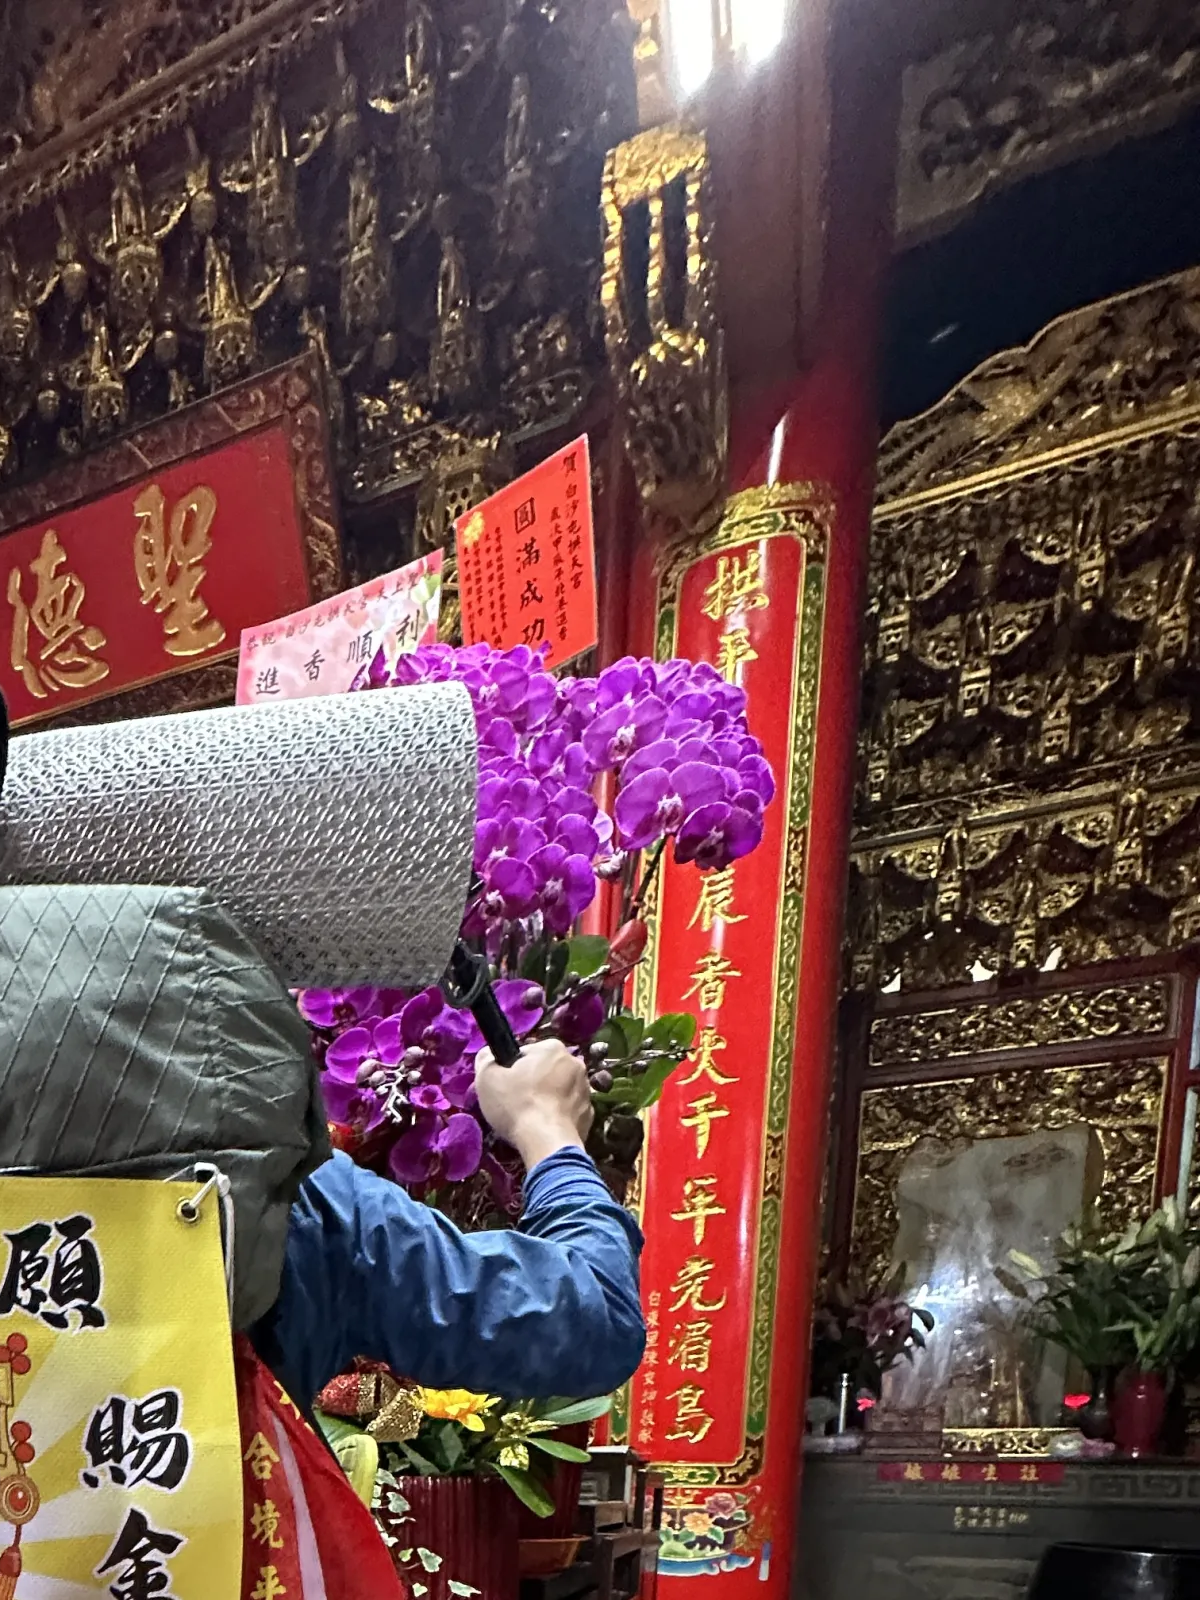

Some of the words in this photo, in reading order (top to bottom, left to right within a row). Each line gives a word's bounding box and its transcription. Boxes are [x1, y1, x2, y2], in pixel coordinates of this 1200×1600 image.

[514, 497, 545, 645] 圓滿成功
[256, 610, 420, 695] 進香順利
